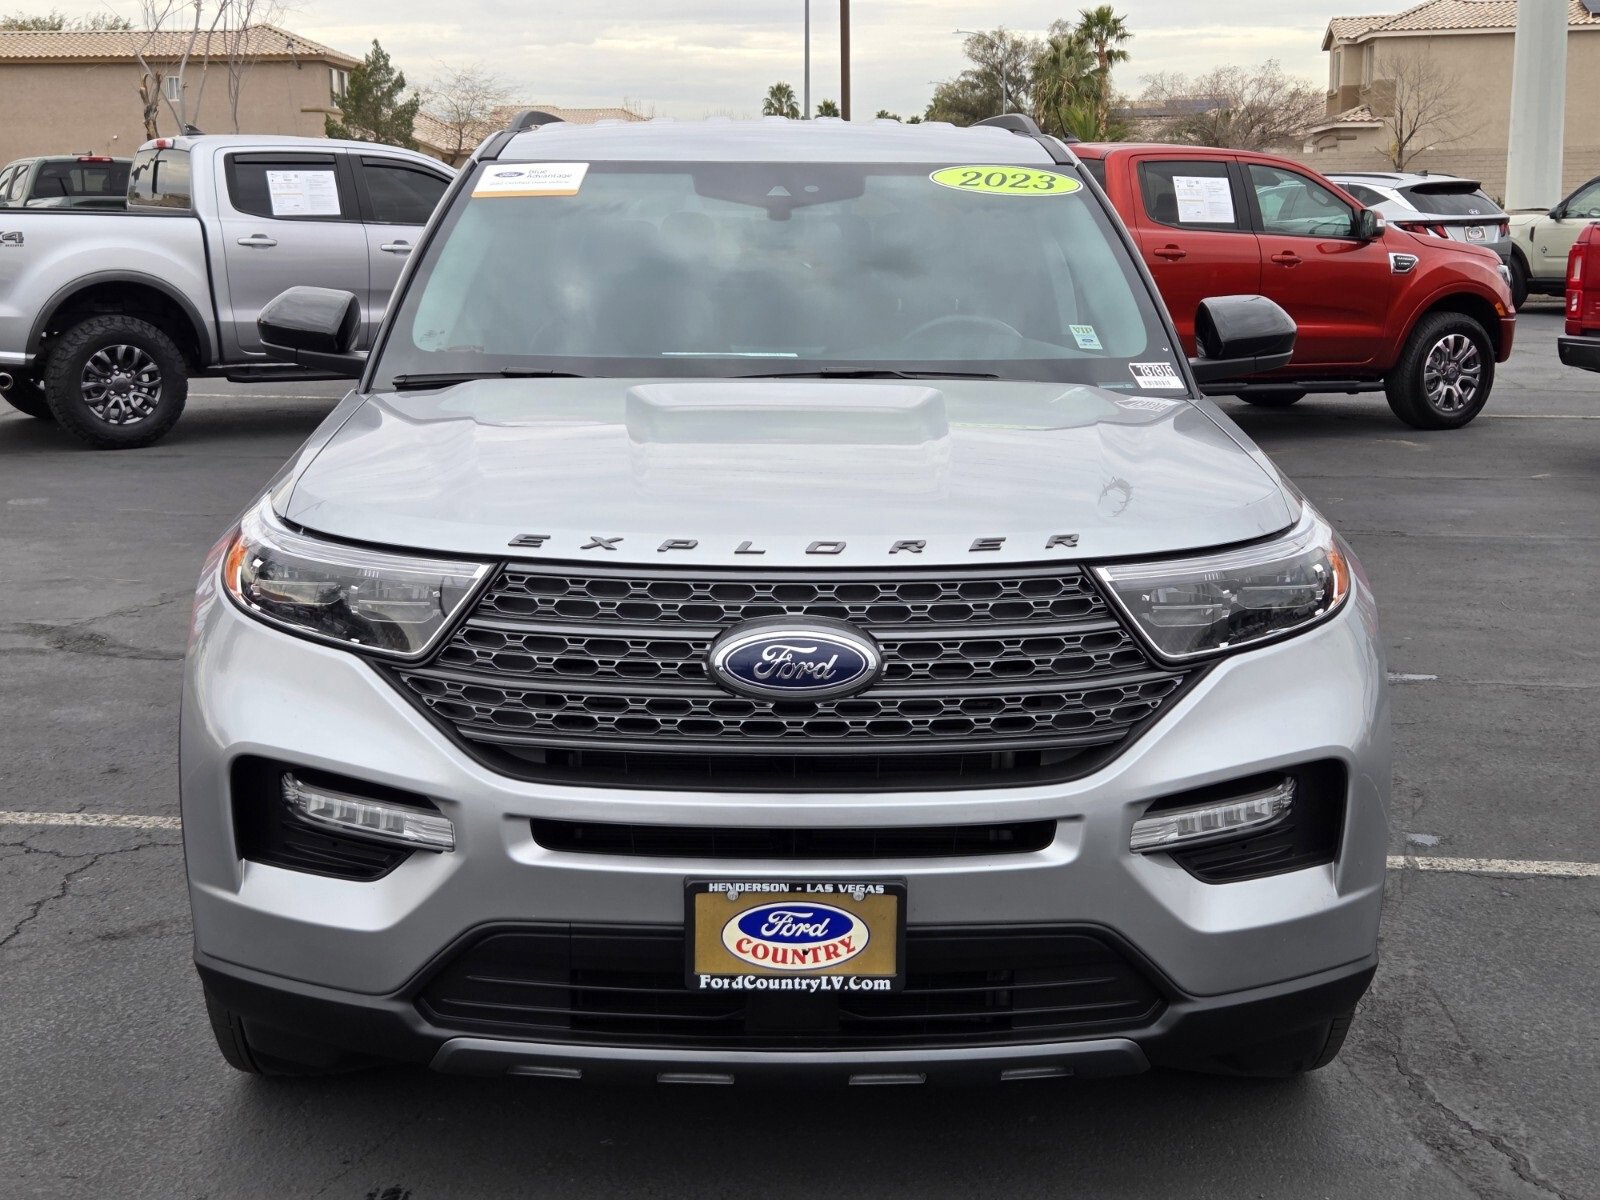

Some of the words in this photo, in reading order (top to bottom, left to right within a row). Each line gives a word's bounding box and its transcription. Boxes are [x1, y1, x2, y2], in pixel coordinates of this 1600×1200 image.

[958, 171, 1057, 190] 2023
[508, 532, 1080, 555] EXPLORER
[753, 644, 839, 680] Ford
[709, 883, 789, 892] HENDERSON
[806, 884, 834, 893] LAS
[839, 885, 885, 894] VEGAS
[761, 910, 831, 938] Ford
[735, 936, 856, 965] COUNTRY
[699, 974, 891, 993] FordCountryLV.Com
